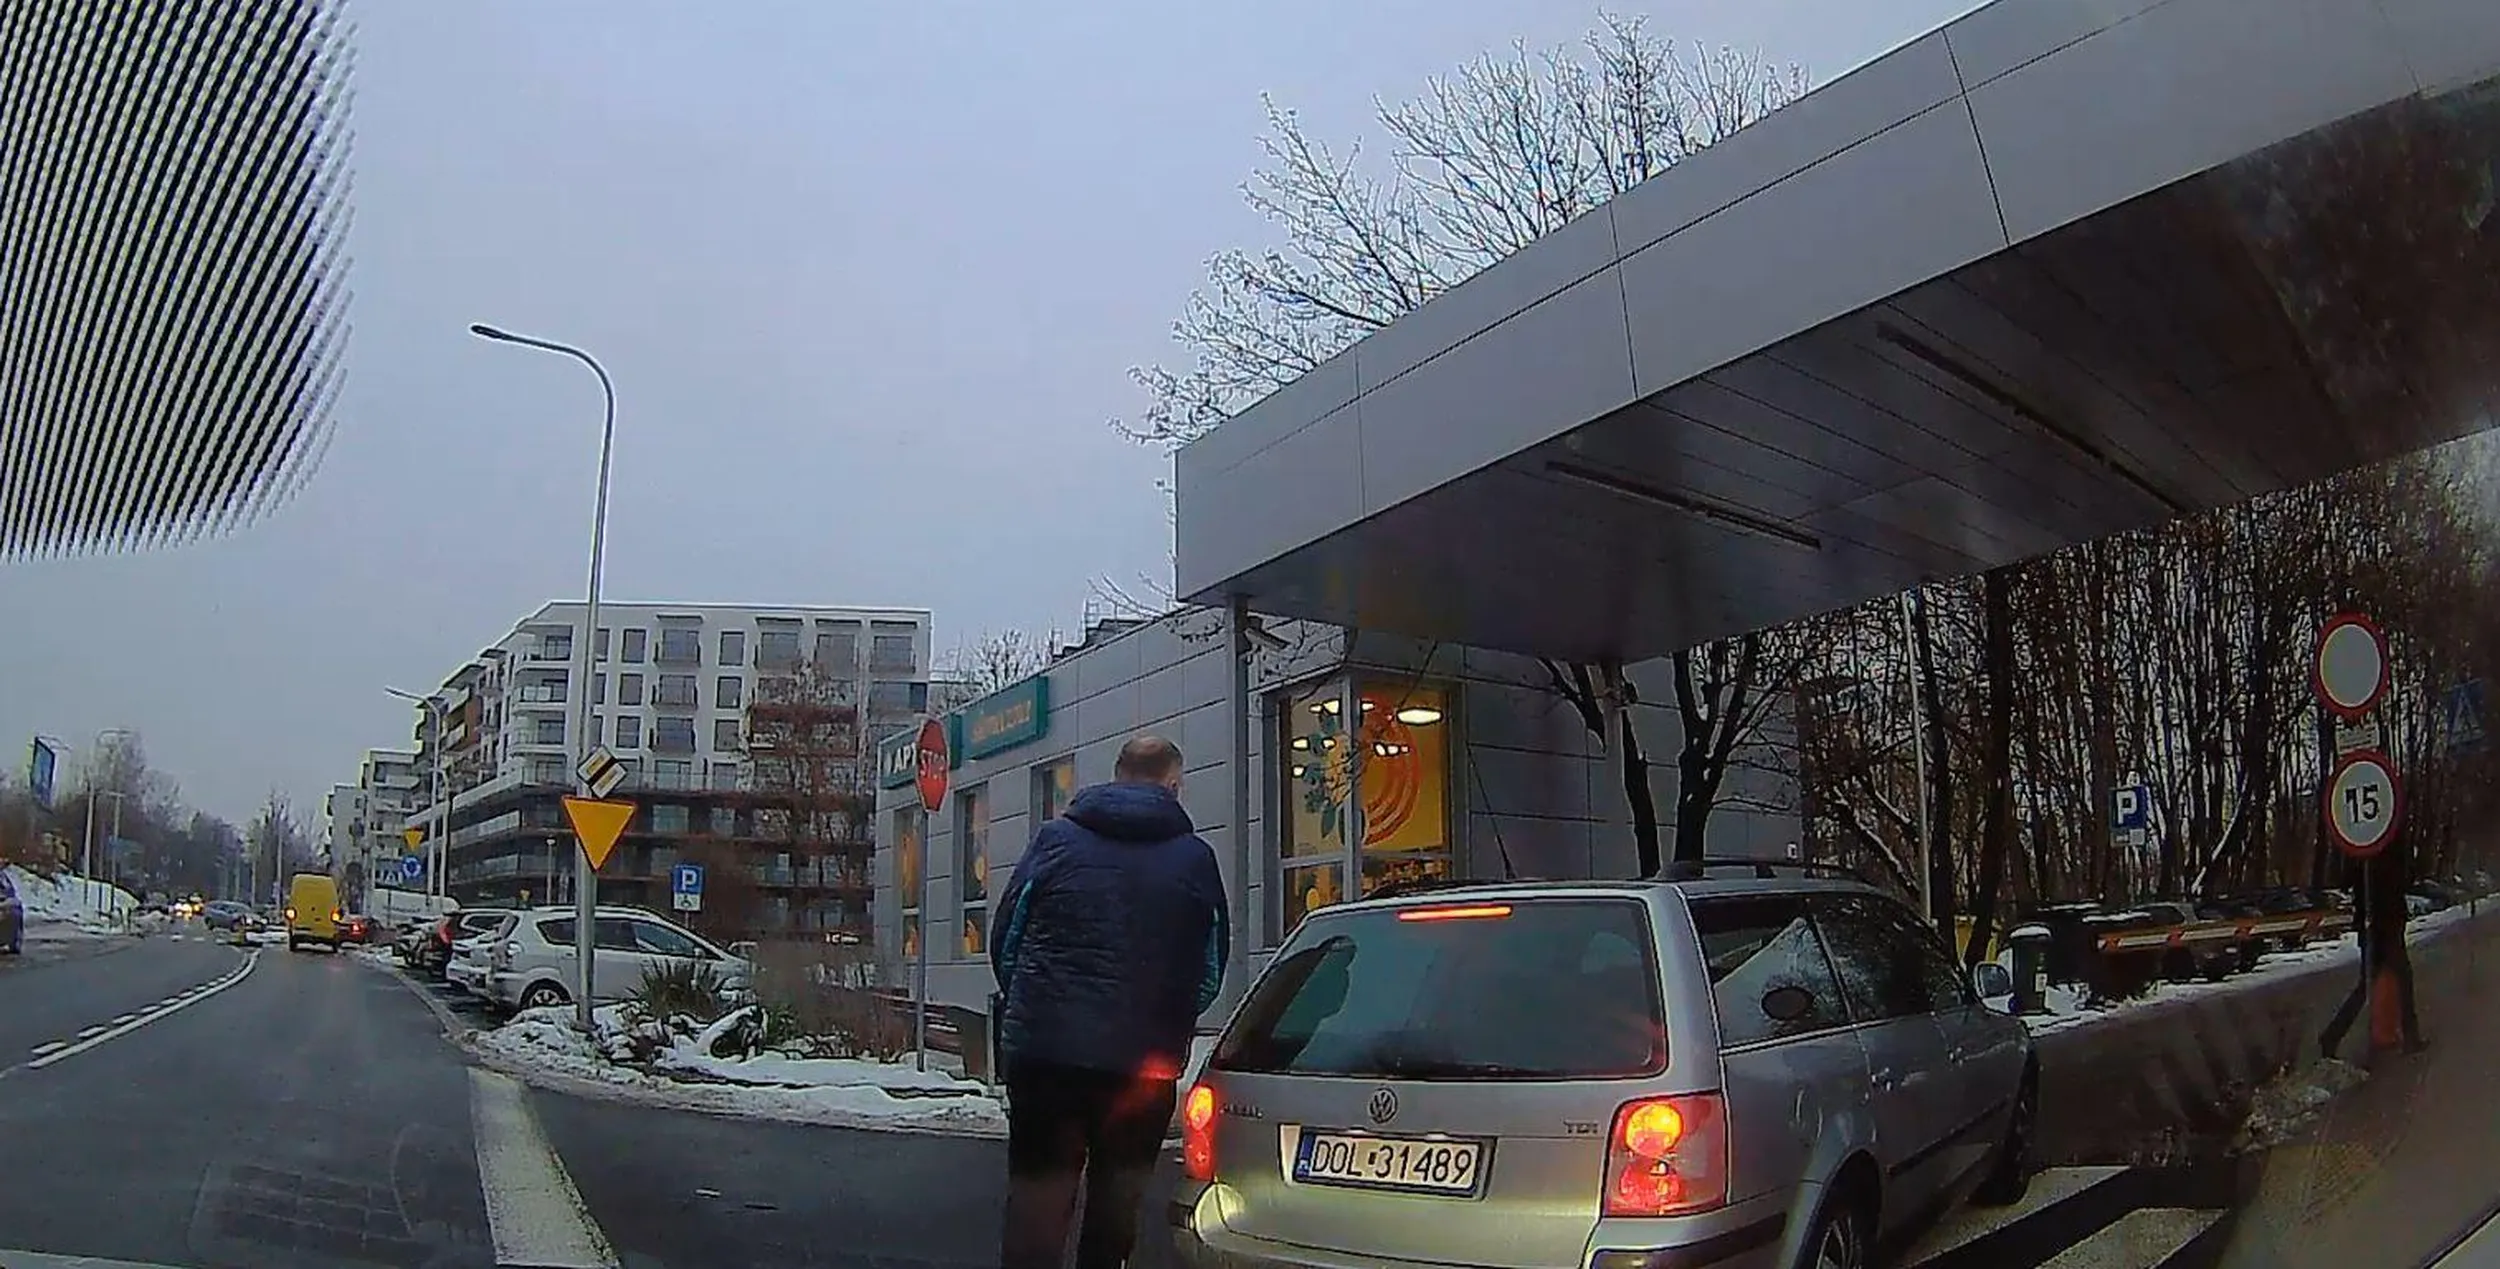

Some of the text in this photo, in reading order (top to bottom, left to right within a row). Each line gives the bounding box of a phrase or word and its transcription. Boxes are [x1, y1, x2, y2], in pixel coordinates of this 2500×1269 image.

[2116, 791, 2137, 824] P
[2345, 784, 2379, 823] 15
[682, 869, 697, 891] P
[1312, 1140, 1472, 1183] DOL 31489
